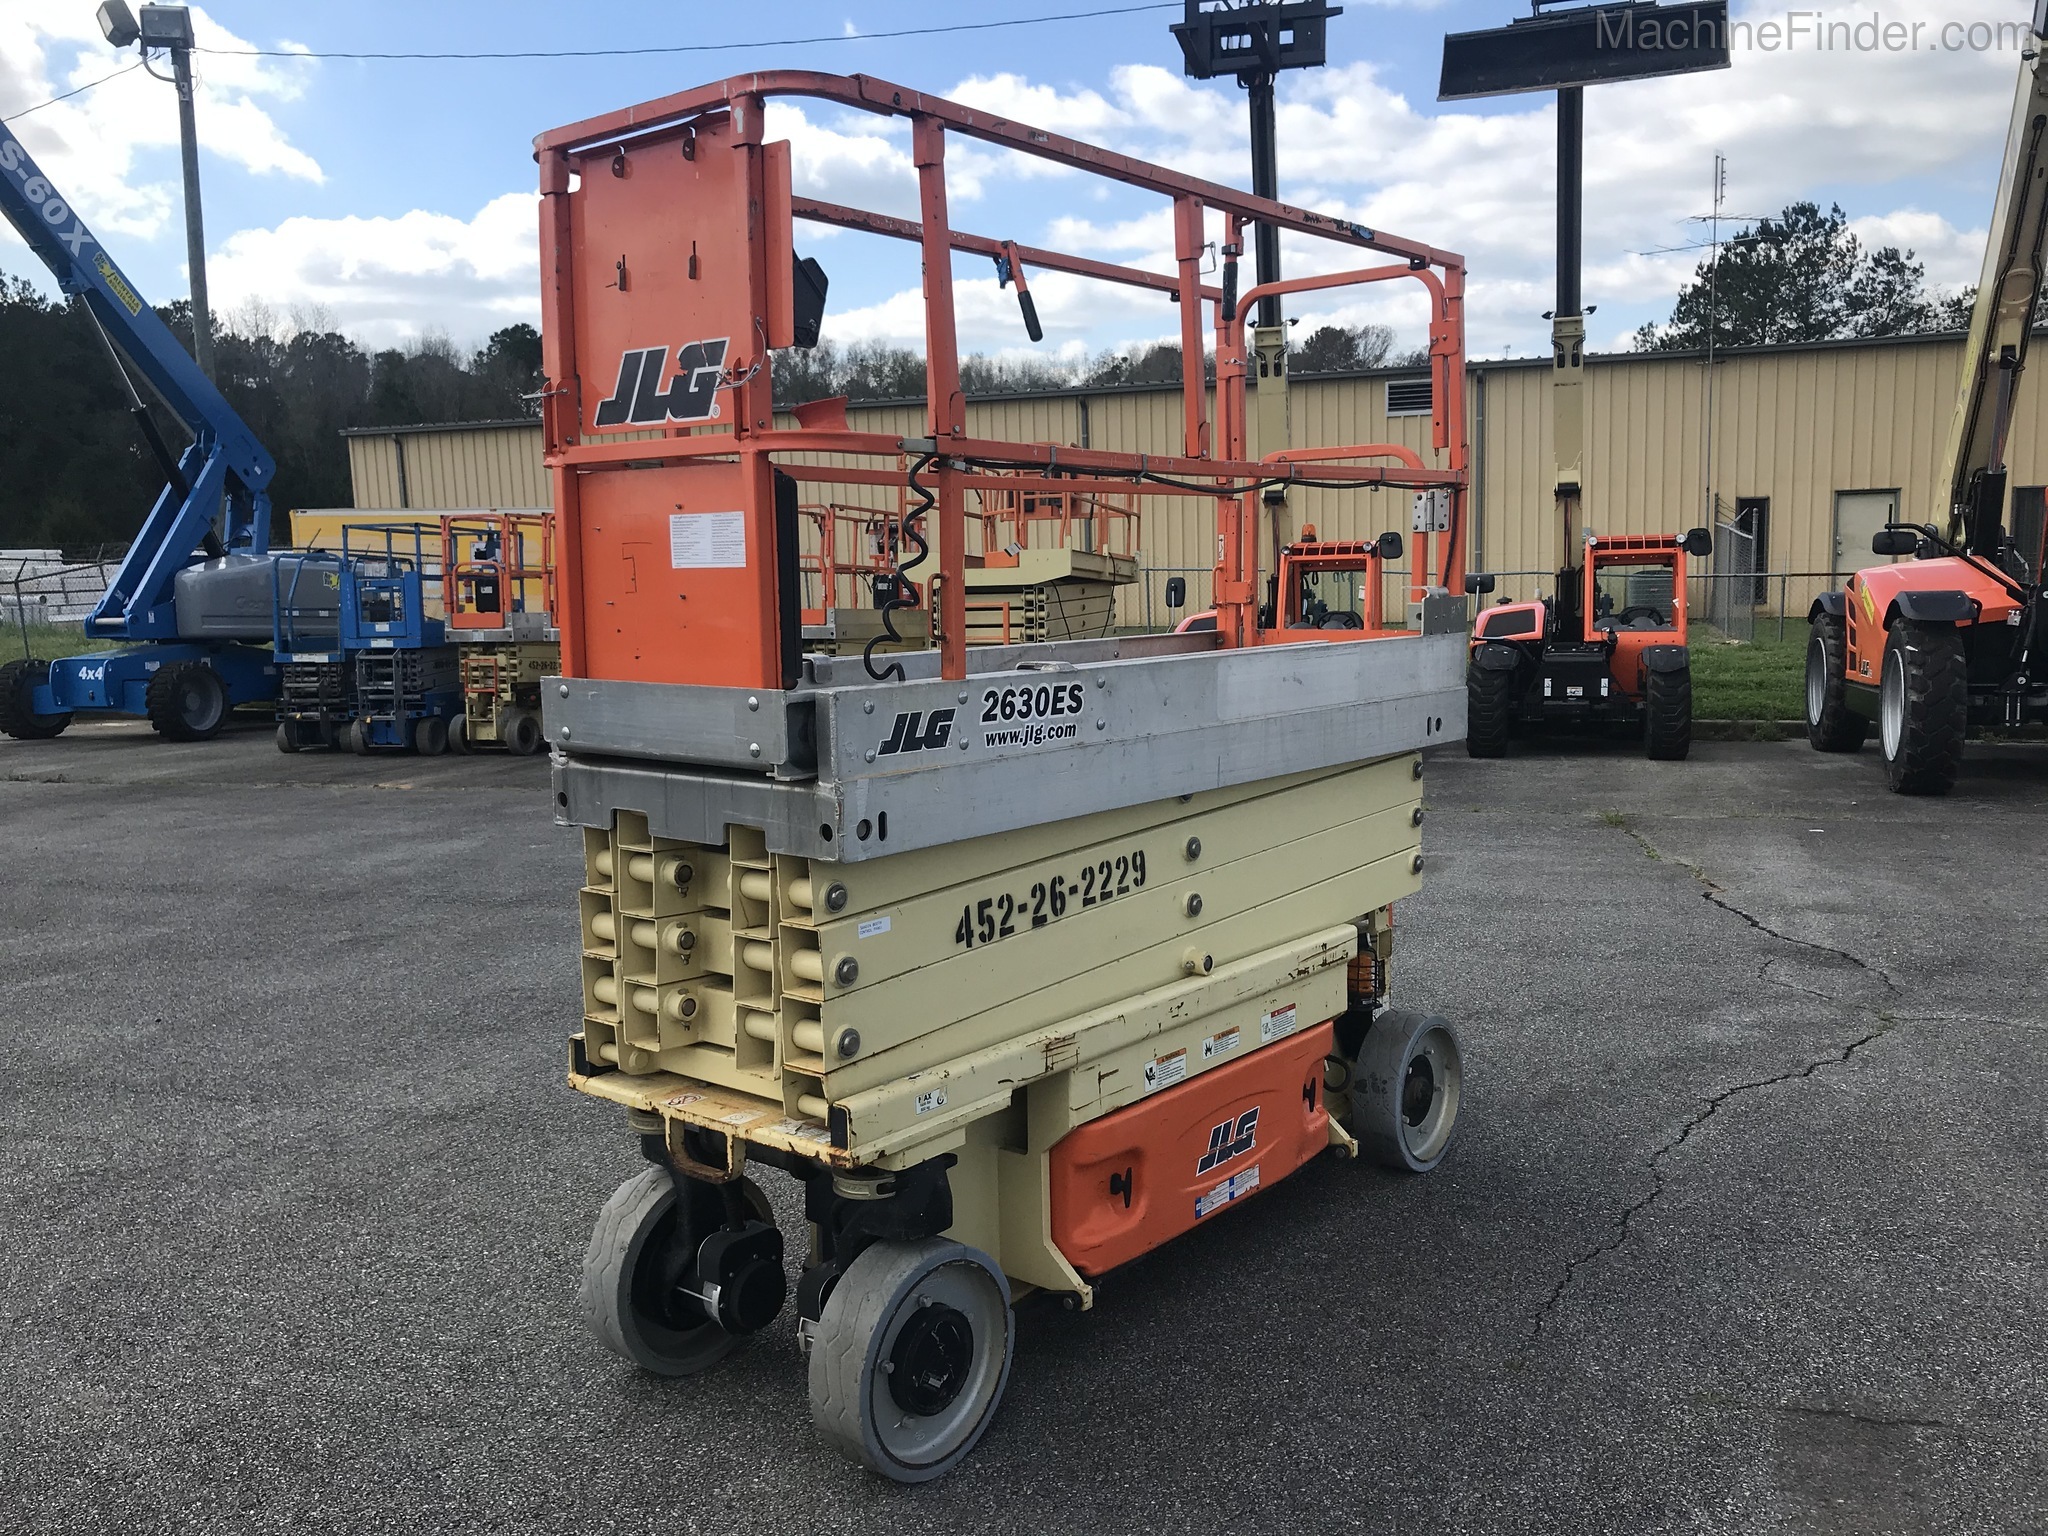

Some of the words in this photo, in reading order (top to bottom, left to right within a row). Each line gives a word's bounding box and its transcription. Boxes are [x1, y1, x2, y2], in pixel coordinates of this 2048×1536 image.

[0, 140, 95, 258] S-60X
[594, 337, 730, 428] JLG
[78, 666, 103, 680] 4x4
[979, 682, 1086, 725] 2630ES
[876, 707, 958, 757] JLG
[984, 722, 1078, 748] www.jlg.com
[955, 850, 1147, 949] 452-26-2229
[1196, 1105, 1260, 1177] JLG
